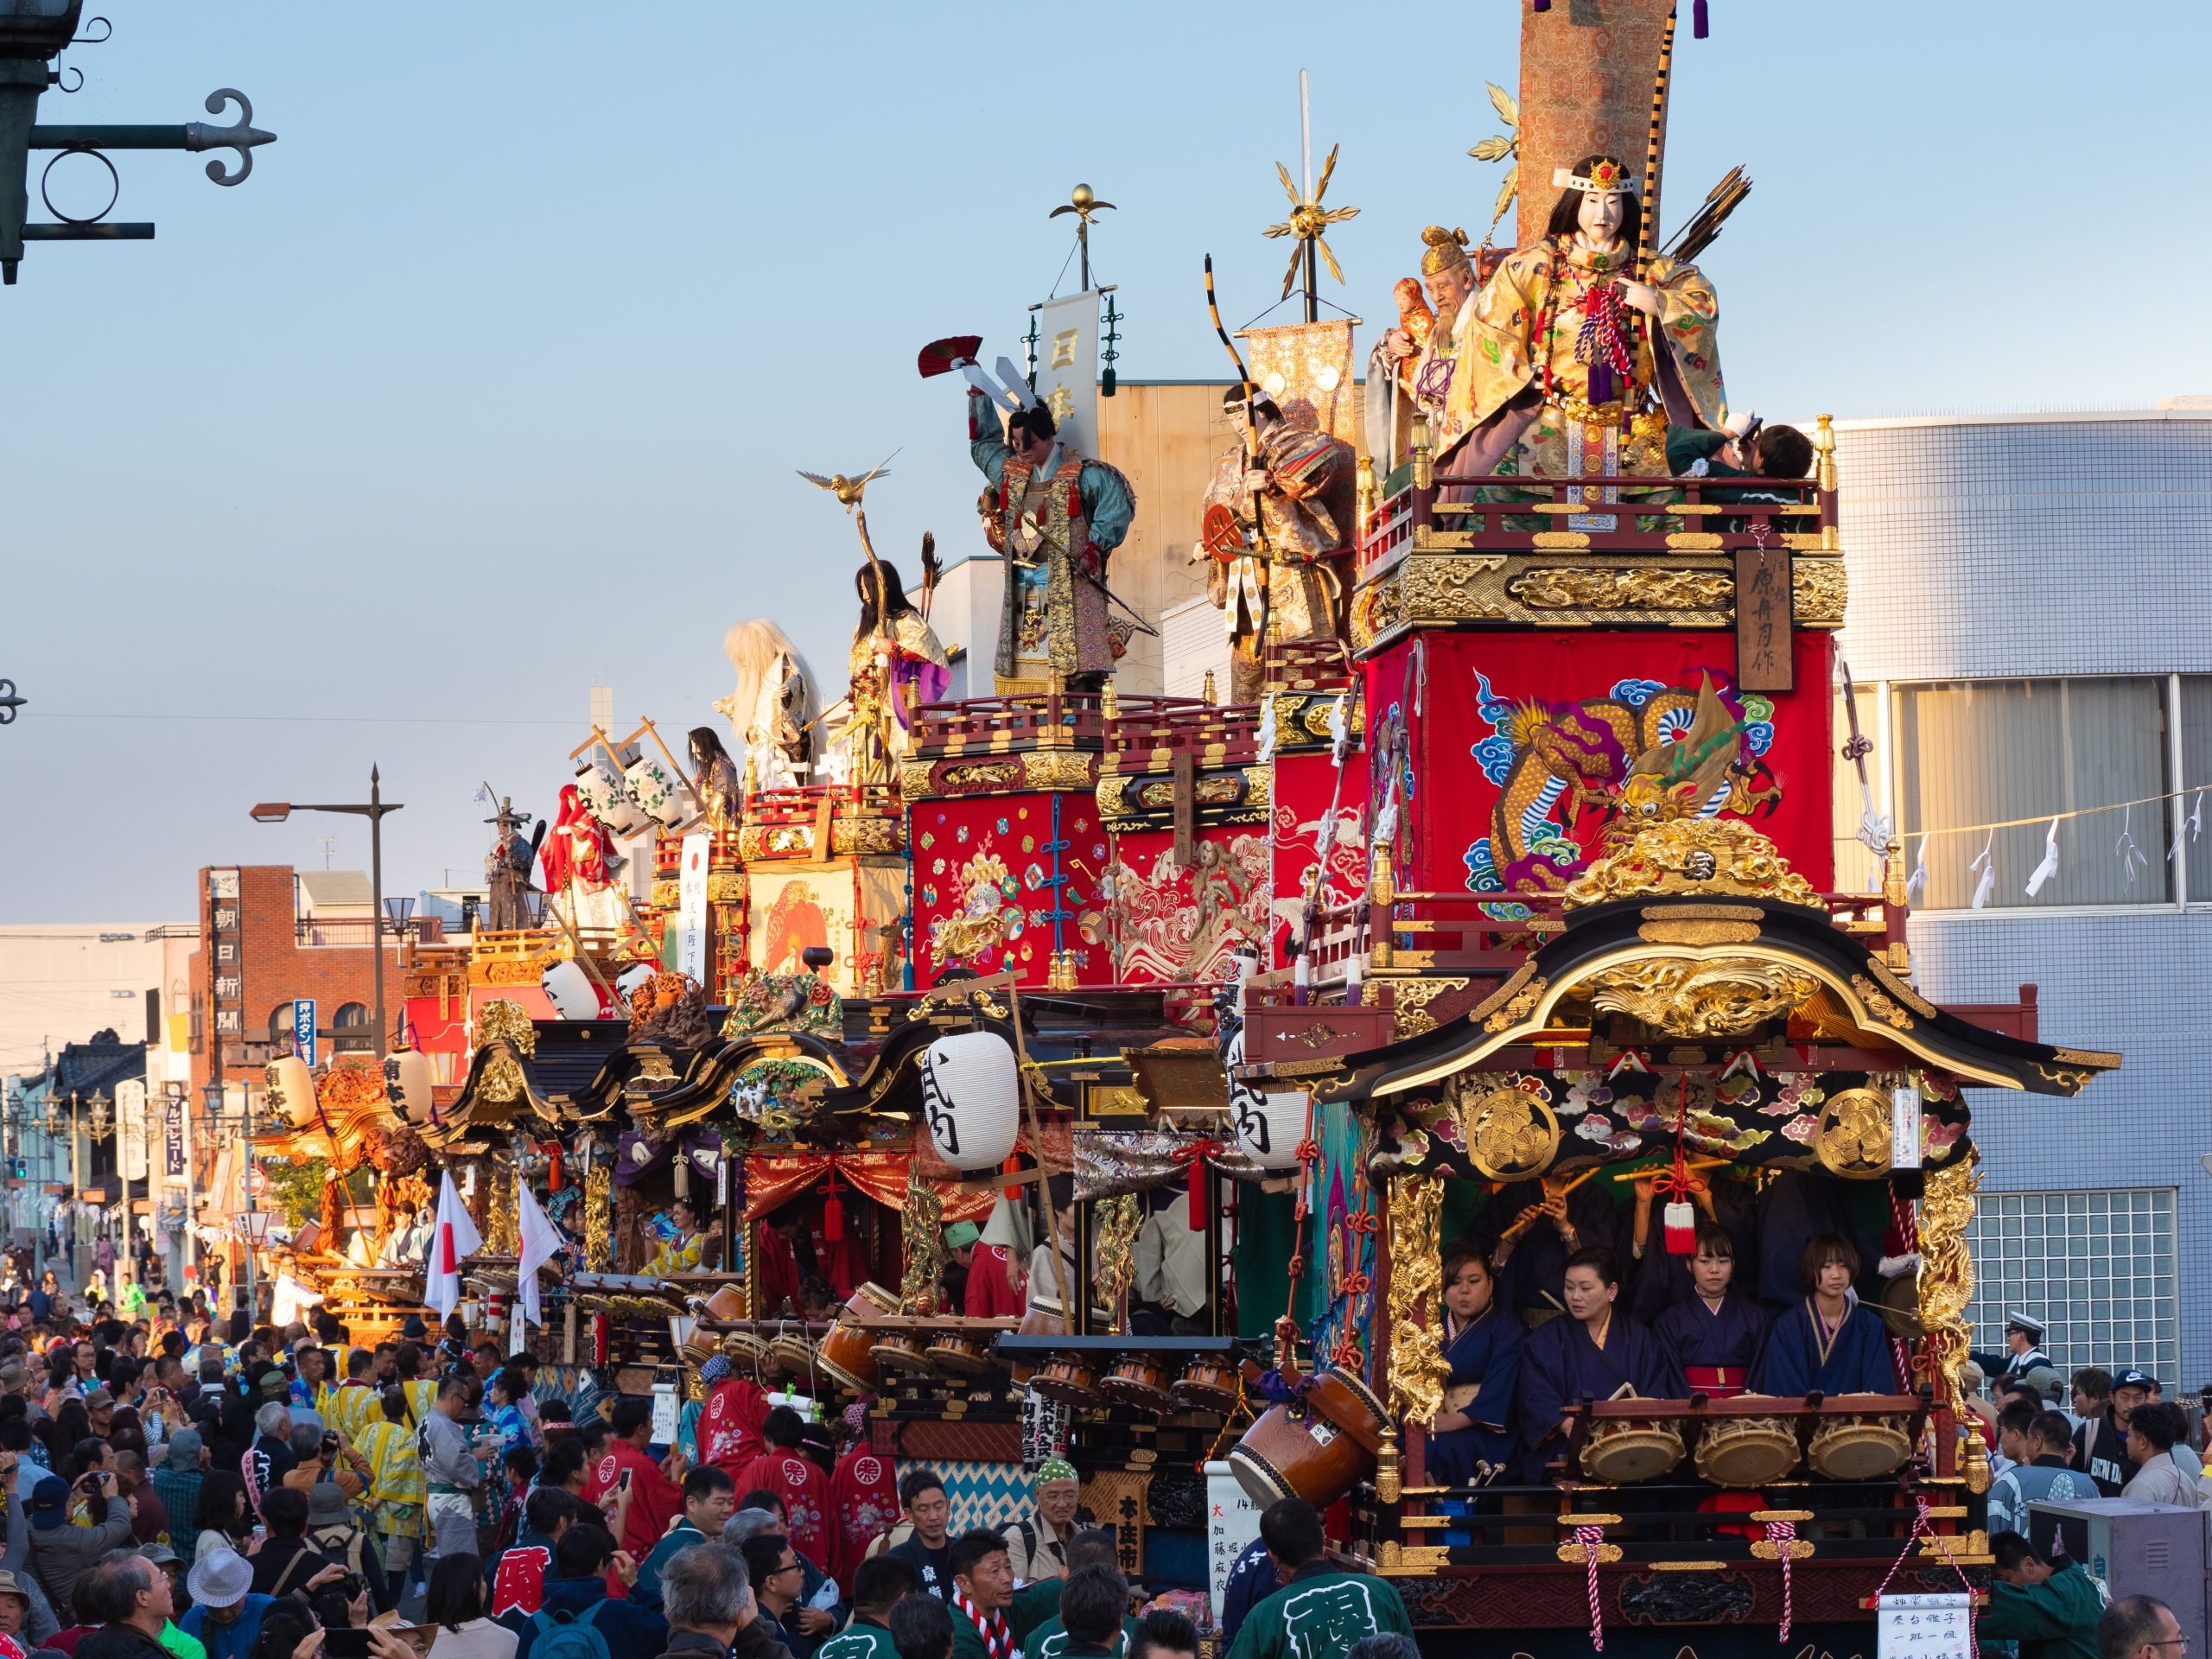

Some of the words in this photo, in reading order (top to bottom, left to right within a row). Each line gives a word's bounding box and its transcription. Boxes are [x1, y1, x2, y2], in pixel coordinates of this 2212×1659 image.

[215, 909, 239, 1031] 朝日新聞
[2091, 1456, 2110, 1481] BEN
[1211, 1503, 1224, 1517] 大
[1212, 1524, 1227, 1592] 加藤麻衣
